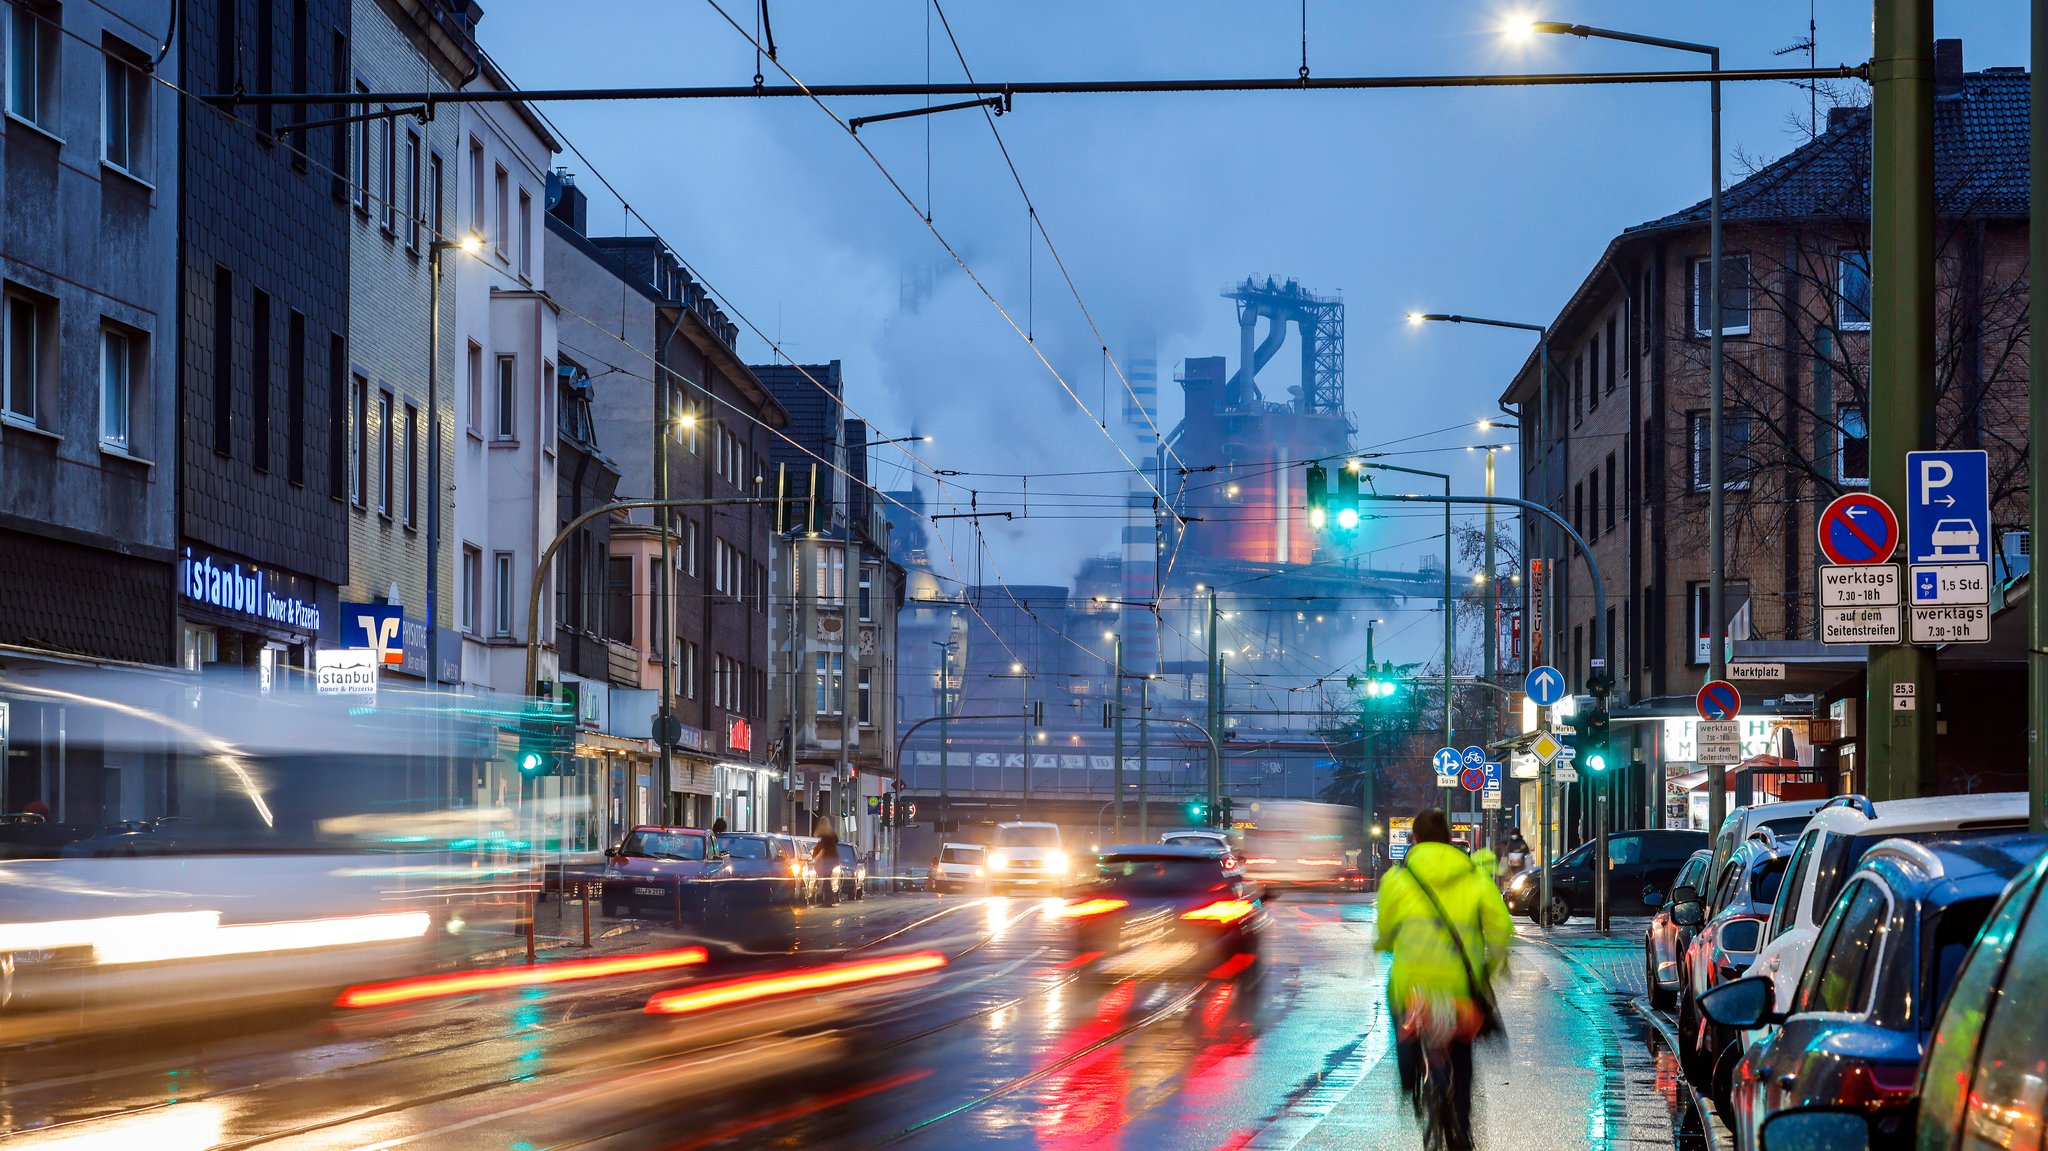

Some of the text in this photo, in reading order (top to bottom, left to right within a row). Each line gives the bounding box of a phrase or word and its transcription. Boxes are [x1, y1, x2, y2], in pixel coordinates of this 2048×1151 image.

[1921, 460, 1953, 505] P
[1827, 571, 1894, 586] werktags
[1959, 578, 1983, 590] Std.
[186, 546, 263, 616] istanbul
[295, 600, 320, 630] Pizzeria
[1840, 610, 1882, 621] auf dem
[1916, 607, 1984, 622] werktags
[1827, 624, 1896, 636] Seitenstreifen
[318, 670, 375, 684] istanbul
[1732, 666, 1779, 678] Marktplatz
[1896, 685, 1914, 694] 25,3
[1900, 700, 1907, 708] 4
[1555, 725, 1576, 734] Marktp
[1700, 725, 1738, 733] werktags
